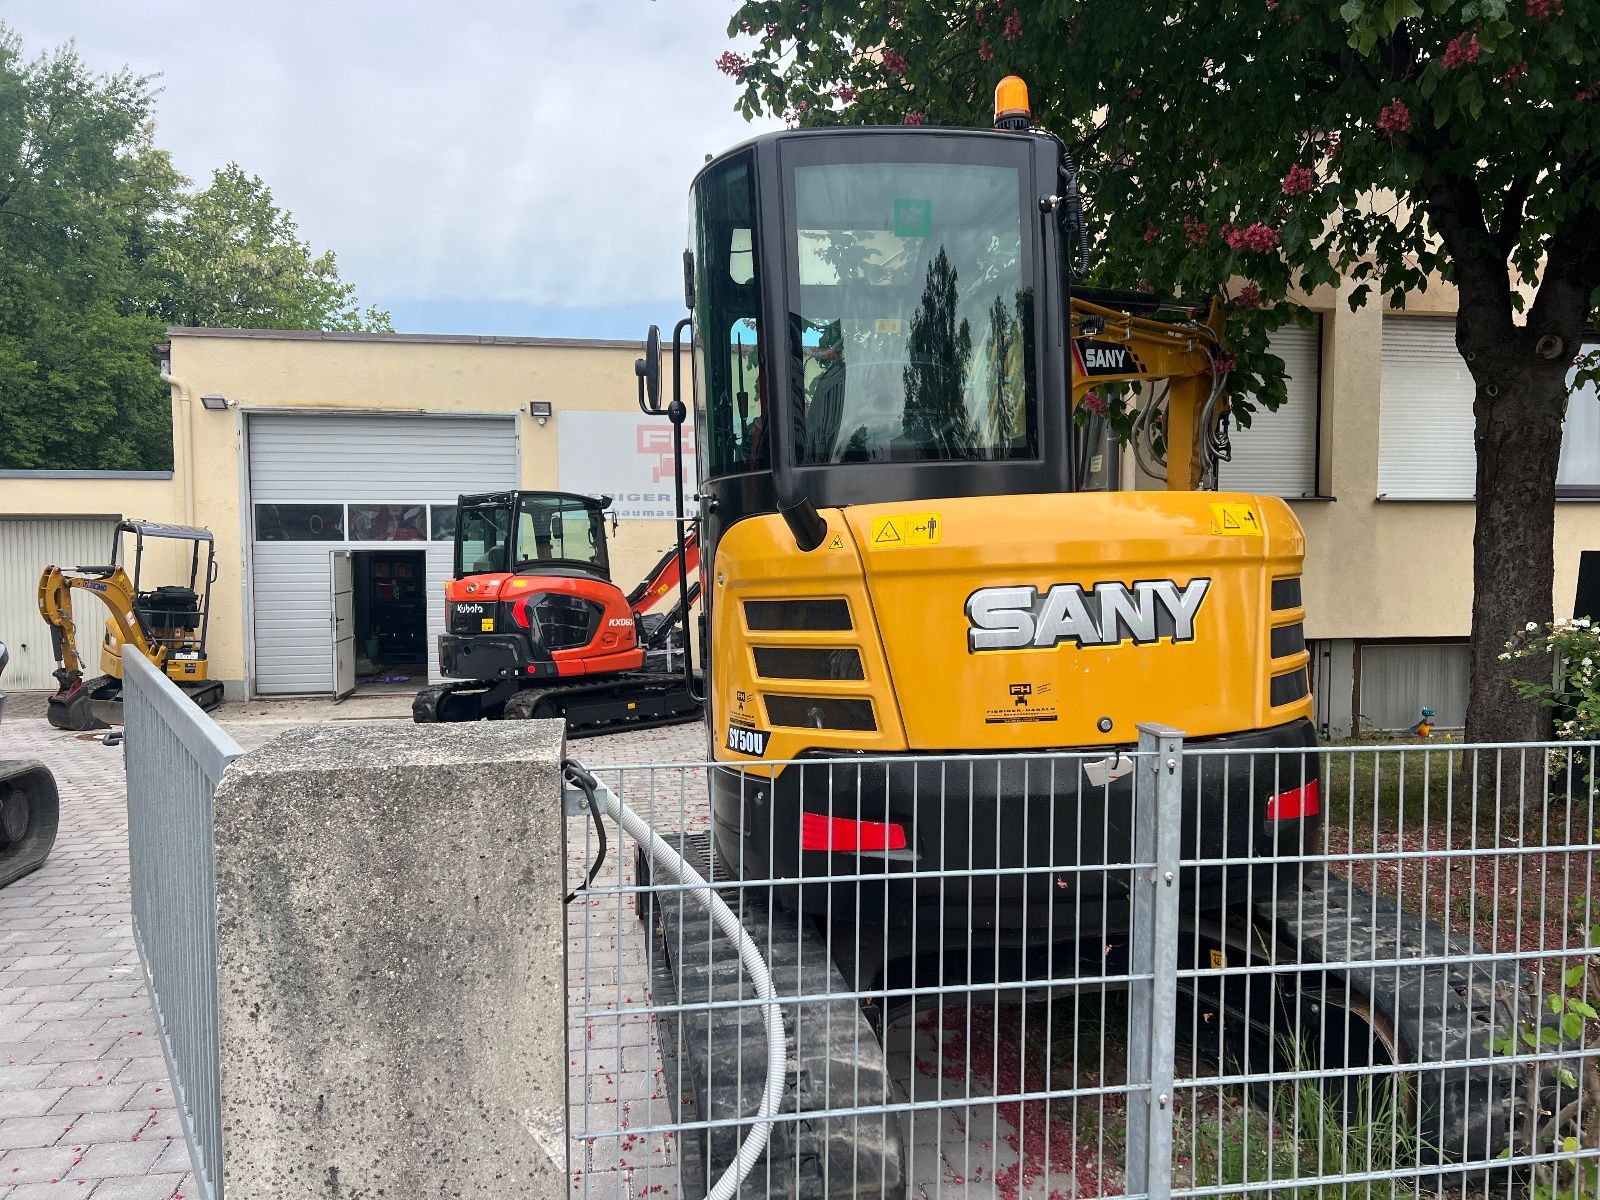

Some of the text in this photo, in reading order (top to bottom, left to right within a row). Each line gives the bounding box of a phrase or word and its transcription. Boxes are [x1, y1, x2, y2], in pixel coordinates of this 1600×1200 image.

[1085, 348, 1126, 368] SANY
[457, 603, 484, 614] Kubota
[965, 578, 1211, 652] SANY
[1010, 685, 1031, 694] FH
[729, 727, 763, 755] SY50U
